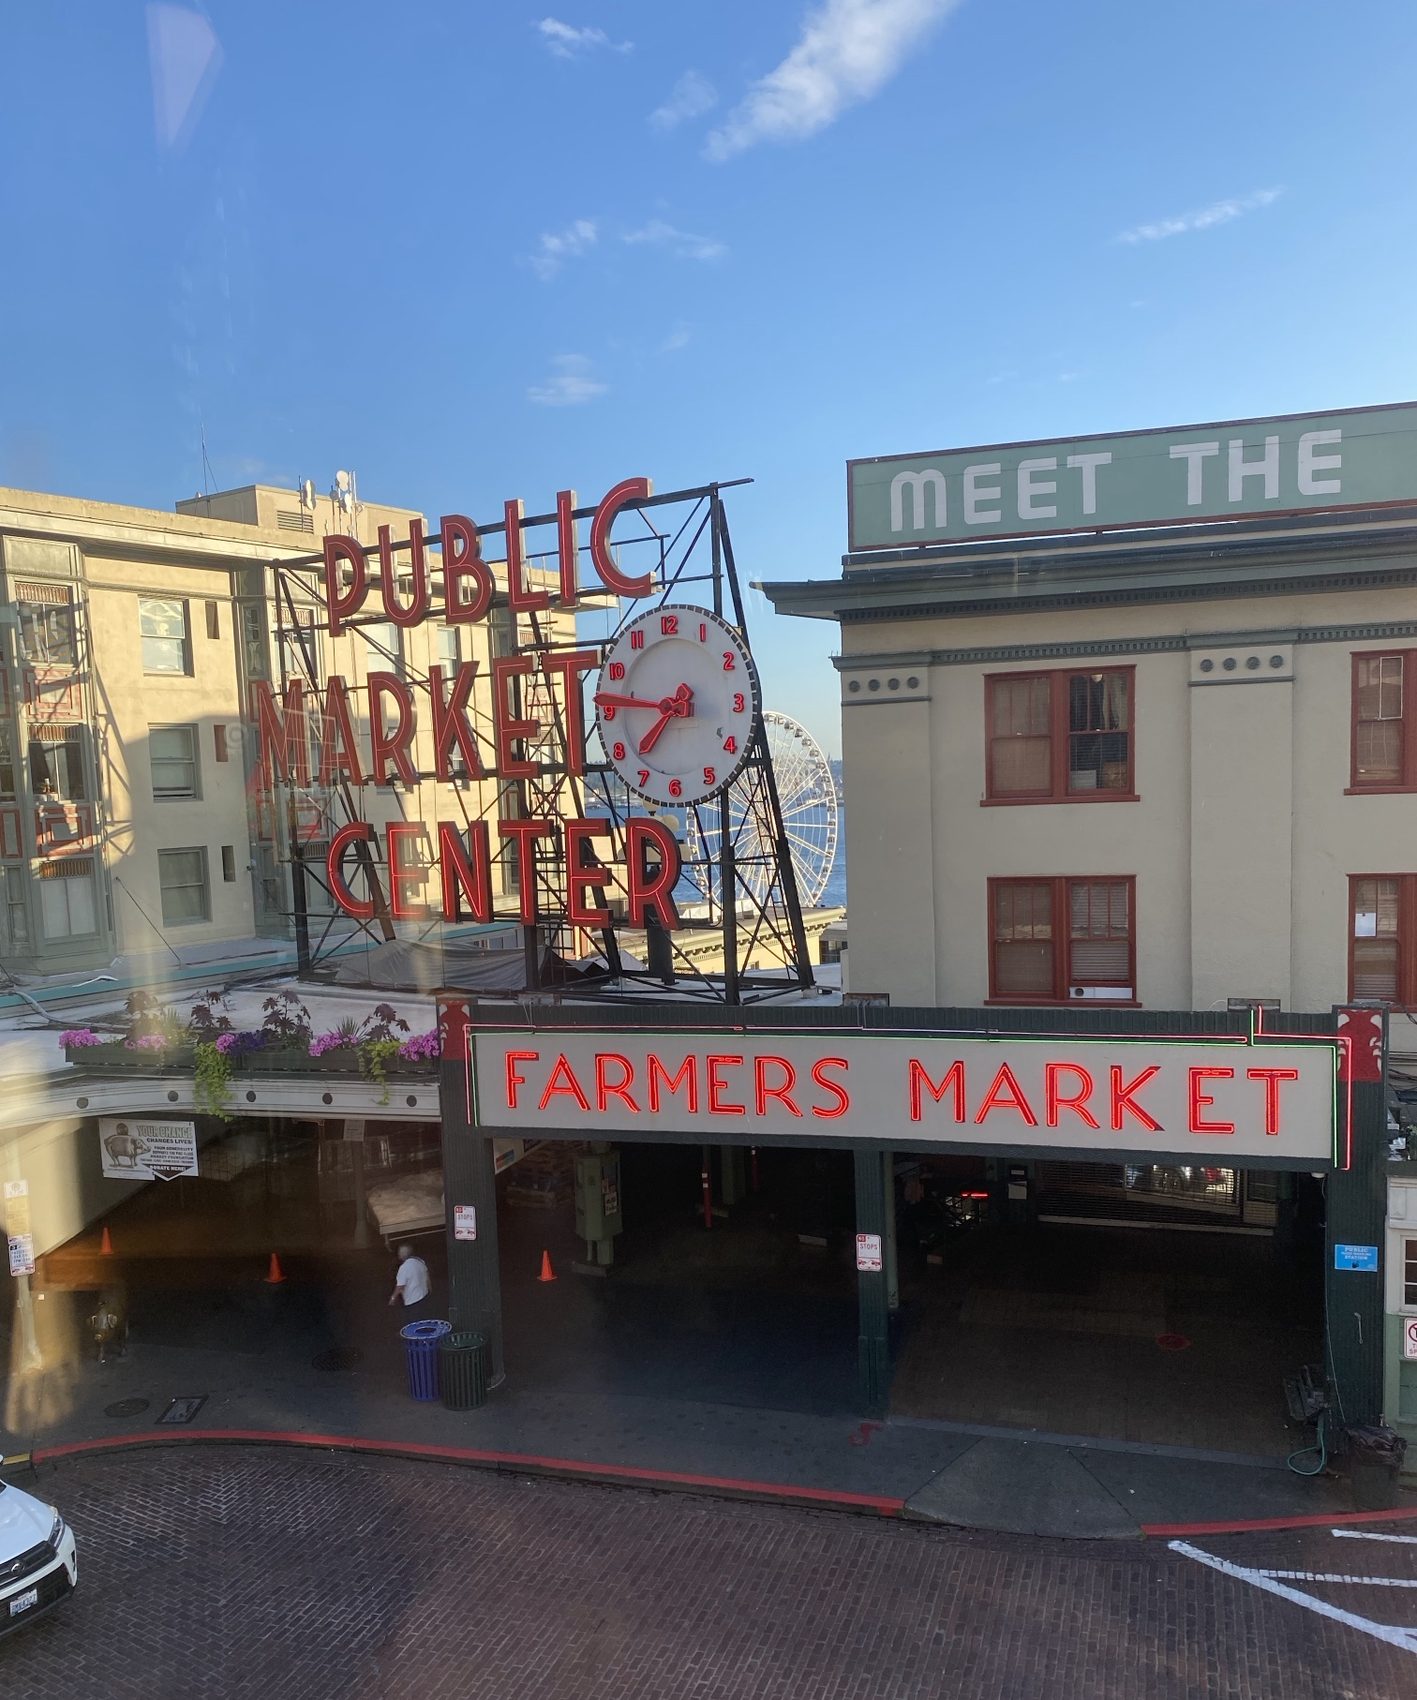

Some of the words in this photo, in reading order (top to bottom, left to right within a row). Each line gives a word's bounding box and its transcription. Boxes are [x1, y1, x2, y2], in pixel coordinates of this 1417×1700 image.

[889, 452, 1112, 533] MEET
[1169, 429, 1342, 506] THE
[323, 477, 655, 637] PUBLIC
[661, 615, 679, 635] 12
[699, 623, 707, 642] 1
[631, 630, 644, 650] 11
[609, 662, 625, 680] 10
[722, 652, 735, 671] 2
[603, 704, 616, 721] 9
[732, 693, 745, 713] 3
[257, 650, 600, 791] MARKET
[613, 742, 625, 760] 8
[723, 736, 738, 754] 4
[637, 770, 650, 788] 7
[703, 767, 716, 785] 5
[668, 779, 682, 797] 6
[327, 818, 682, 930] CENTER
[504, 1050, 850, 1119] FARMERS
[909, 1059, 1298, 1136] MARKET
[136, 1125, 159, 1137] YOUR
[159, 1126, 193, 1139] CHANGE
